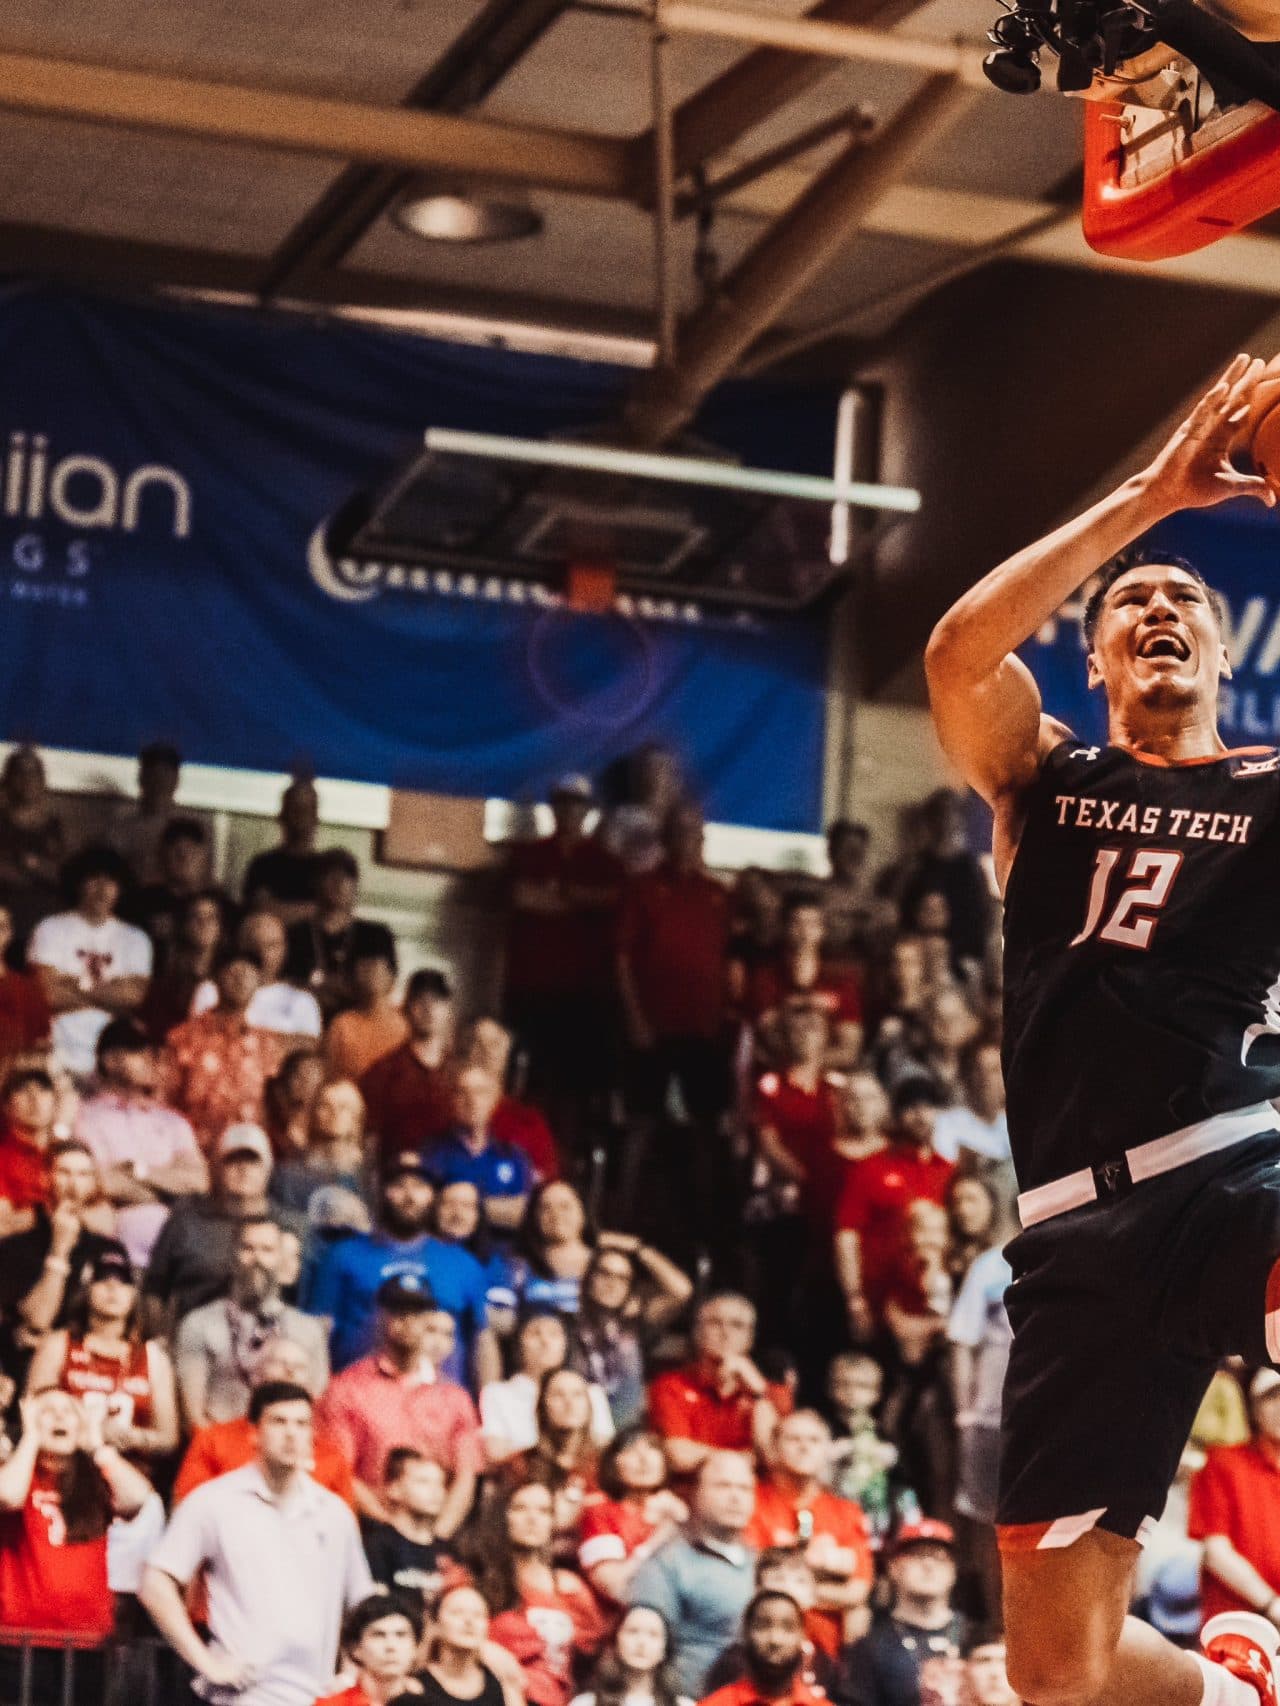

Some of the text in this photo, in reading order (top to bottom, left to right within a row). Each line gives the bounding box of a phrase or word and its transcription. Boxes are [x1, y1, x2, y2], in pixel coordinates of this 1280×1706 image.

[1055, 795, 1253, 845] TEXAS TECH
[1069, 848, 1184, 951] 12
